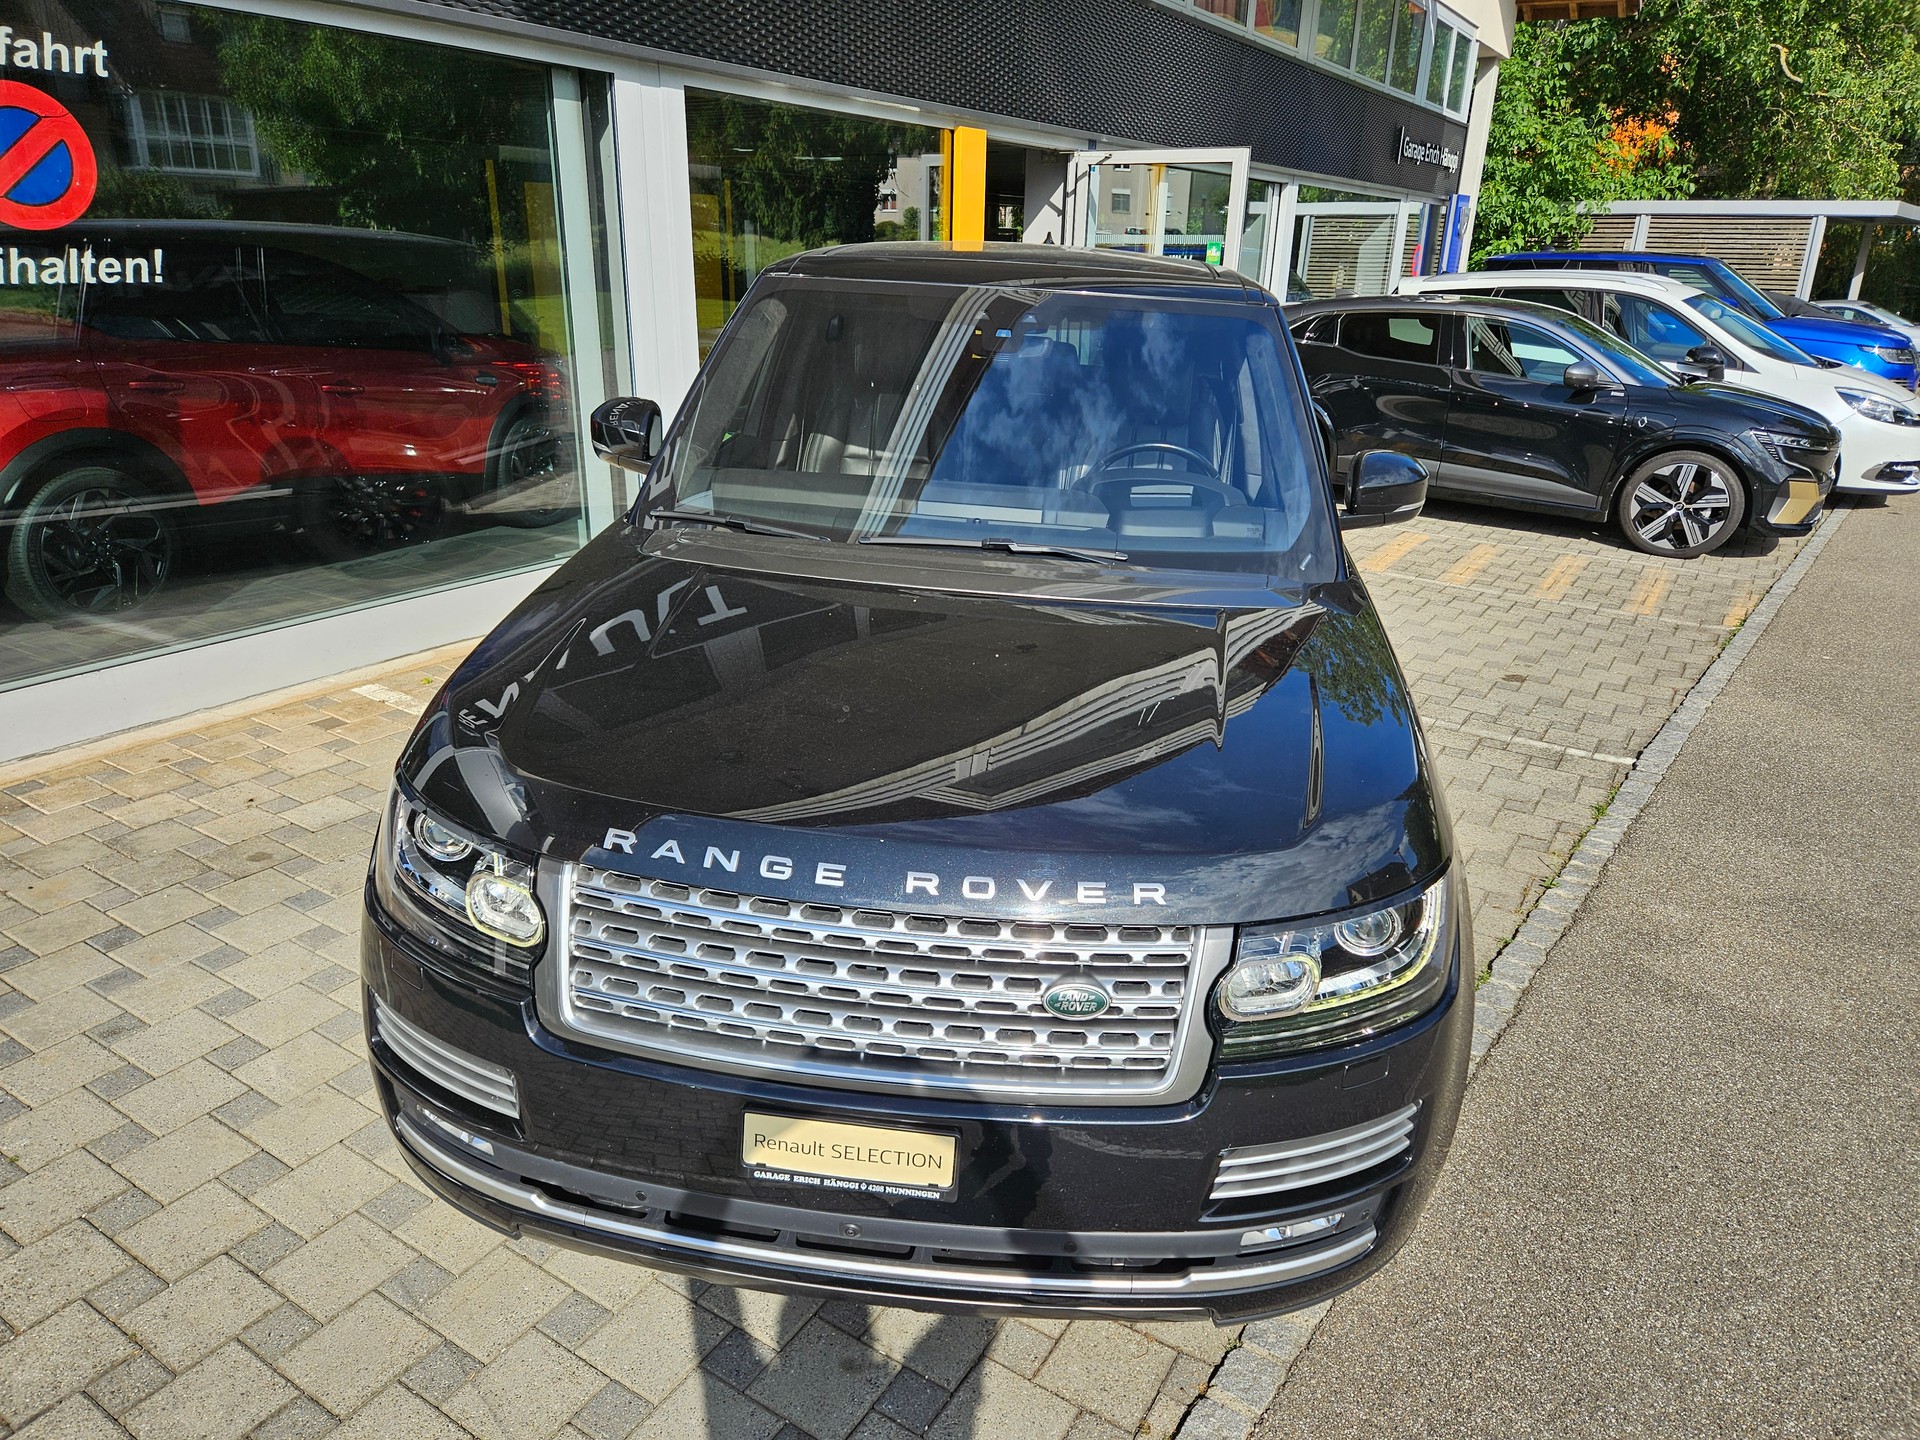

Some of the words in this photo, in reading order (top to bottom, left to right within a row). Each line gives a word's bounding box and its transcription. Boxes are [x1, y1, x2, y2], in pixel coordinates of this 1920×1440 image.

[1403, 136, 1426, 165] Garage
[1425, 142, 1440, 165] Erich
[603, 827, 847, 888] RANGE
[905, 871, 1167, 906] ROVER
[1058, 990, 1089, 1002] LAND
[1060, 1001, 1097, 1012] ROVER
[754, 1133, 825, 1157] Renault
[831, 1144, 943, 1169] SELECTION
[754, 1170, 791, 1182] GARAGE
[793, 1174, 821, 1186] ERICH
[823, 1178, 859, 1190] HÄNGGI
[885, 1186, 940, 1199] NUNNINGEN
